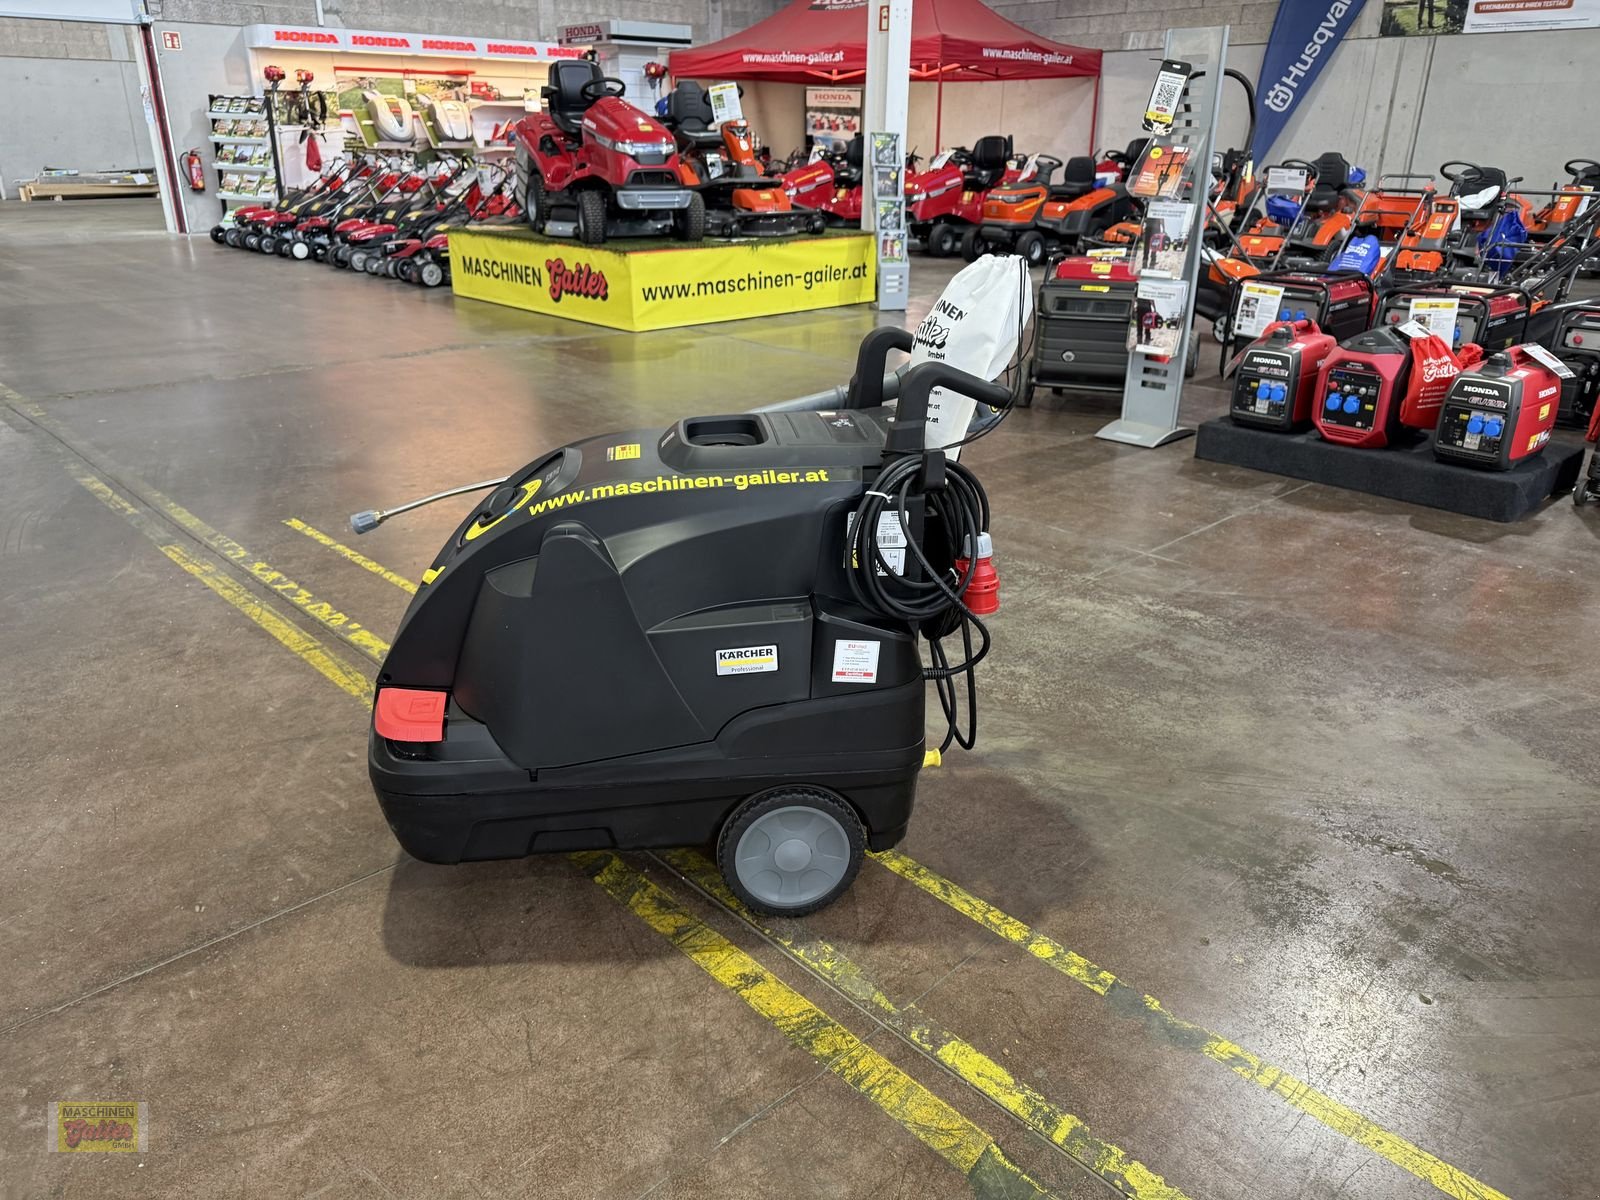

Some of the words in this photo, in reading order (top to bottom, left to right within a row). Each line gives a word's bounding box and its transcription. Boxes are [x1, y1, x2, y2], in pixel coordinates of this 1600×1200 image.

[1525, 1, 1542, 9] IHREN
[565, 24, 602, 37] HONDA
[274, 31, 338, 44] HONDA
[352, 35, 410, 48] HONDA
[422, 39, 476, 52] HONDA
[487, 43, 537, 56] HONDA
[742, 51, 844, 65] www.maschinen-gailer.at
[982, 47, 1073, 65] www.maschinen-gailer.at
[814, 93, 853, 101] HONDA
[462, 255, 542, 287] MASCHINEN
[545, 258, 609, 303] Gailer
[641, 261, 868, 301] www.maschinen-gailer.at
[1252, 356, 1283, 366] HONDA
[1463, 385, 1500, 396] HONDA
[1538, 385, 1557, 399] HONDA
[528, 469, 829, 517] www.maschinen-gailer.at
[719, 648, 774, 661] KÄRCHER
[731, 665, 764, 673] Professional
